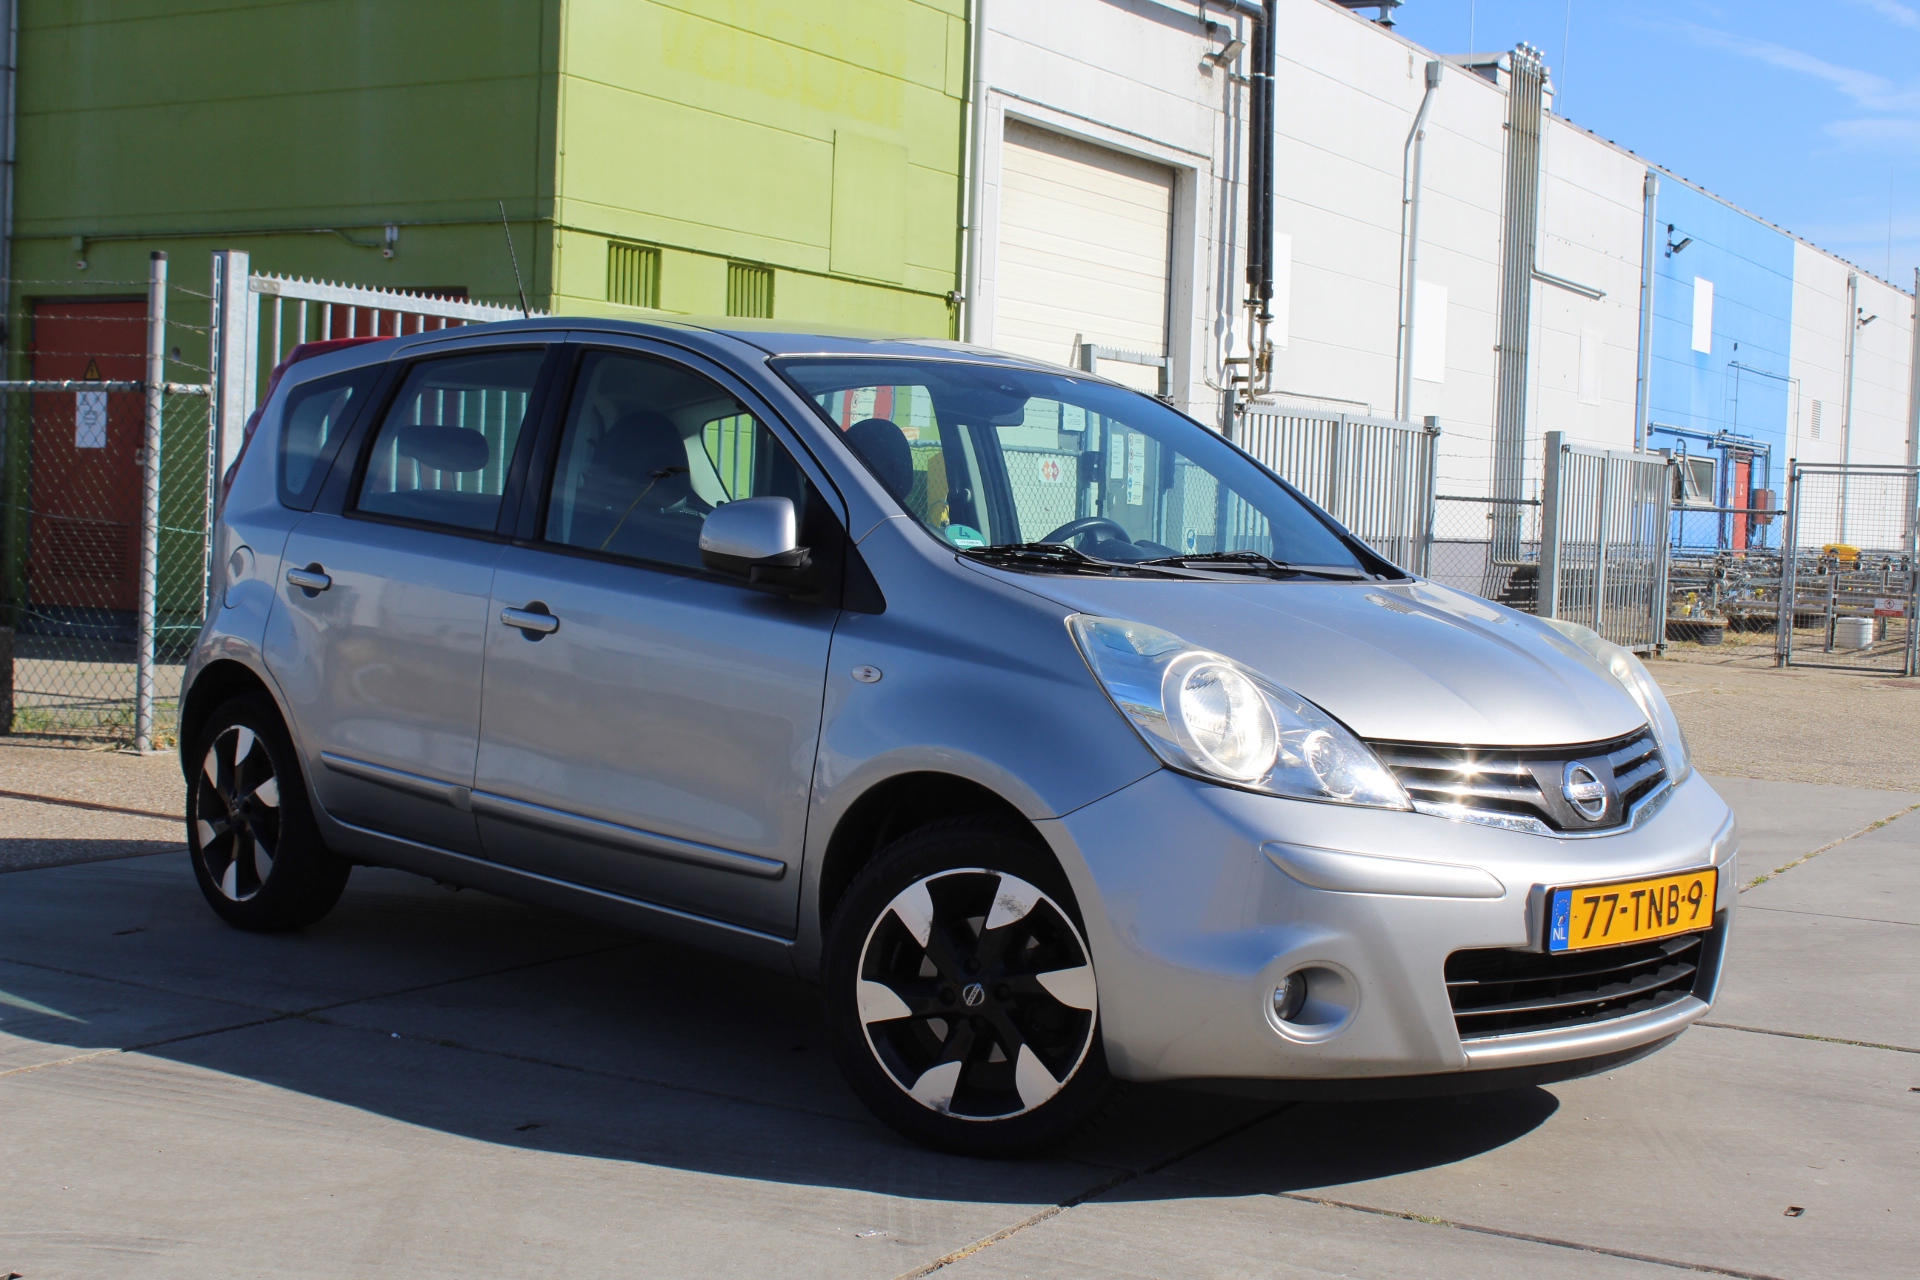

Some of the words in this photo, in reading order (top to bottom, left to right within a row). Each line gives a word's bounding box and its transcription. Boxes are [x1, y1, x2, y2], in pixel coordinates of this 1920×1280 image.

[958, 526, 970, 538] 4
[1583, 879, 1703, 939] 77-TNB-9
[1552, 927, 1567, 941] NL
